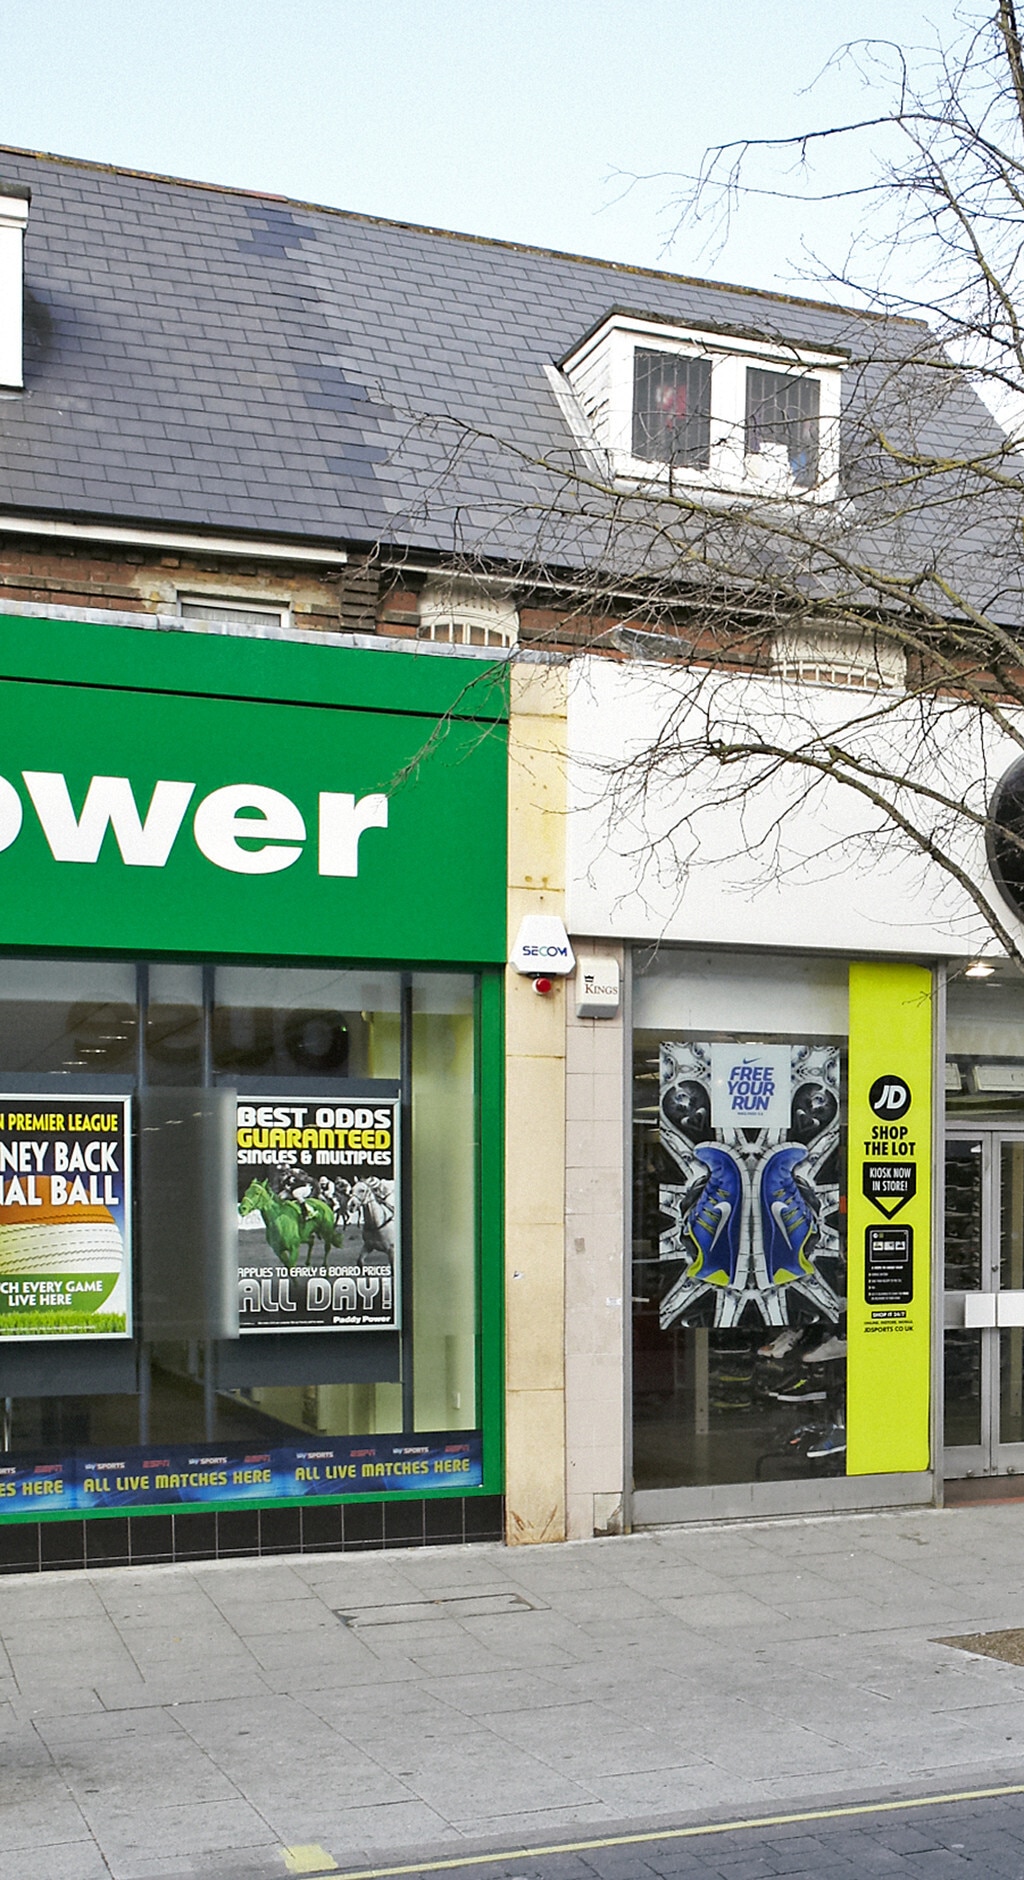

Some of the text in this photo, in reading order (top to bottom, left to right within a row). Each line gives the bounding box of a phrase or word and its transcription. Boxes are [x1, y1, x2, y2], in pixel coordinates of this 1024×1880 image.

[0, 771, 389, 878] wer
[522, 945, 567, 957] SECOM
[730, 1066, 774, 1081] FREE
[728, 1081, 776, 1096] YOUR
[731, 1096, 769, 1111] RUN
[873, 1085, 907, 1110] JD
[8, 1113, 65, 1131] PREMIER
[68, 1113, 118, 1131] LEAGUE
[237, 1106, 391, 1129] BEST ODDS
[237, 1128, 391, 1149] GUARANTEED
[872, 1126, 908, 1140] SHOP
[55, 1141, 119, 1172] BACK
[237, 1149, 391, 1165] SINGLES & MULTIPLES
[864, 1142, 916, 1156] THE LOT
[869, 1167, 912, 1179] KIOSK NOW
[51, 1174, 119, 1205] BALL
[872, 1180, 908, 1192] IN STORE!
[238, 1267, 273, 1277] APPLIES
[275, 1267, 288, 1277] TO
[290, 1266, 318, 1277] EARLY
[328, 1266, 360, 1276] BOARD
[362, 1265, 391, 1276] PRICES
[23, 1281, 62, 1293] EVERY
[65, 1280, 103, 1292] GAME
[238, 1277, 392, 1312] ALL DAY!
[8, 1293, 72, 1306] LIVE HERE
[295, 1458, 470, 1481] ALL LIVE MATCHES HERE
[22, 1479, 63, 1495] HERE
[83, 1469, 271, 1493] ALL LIVE MATCHES HERE
